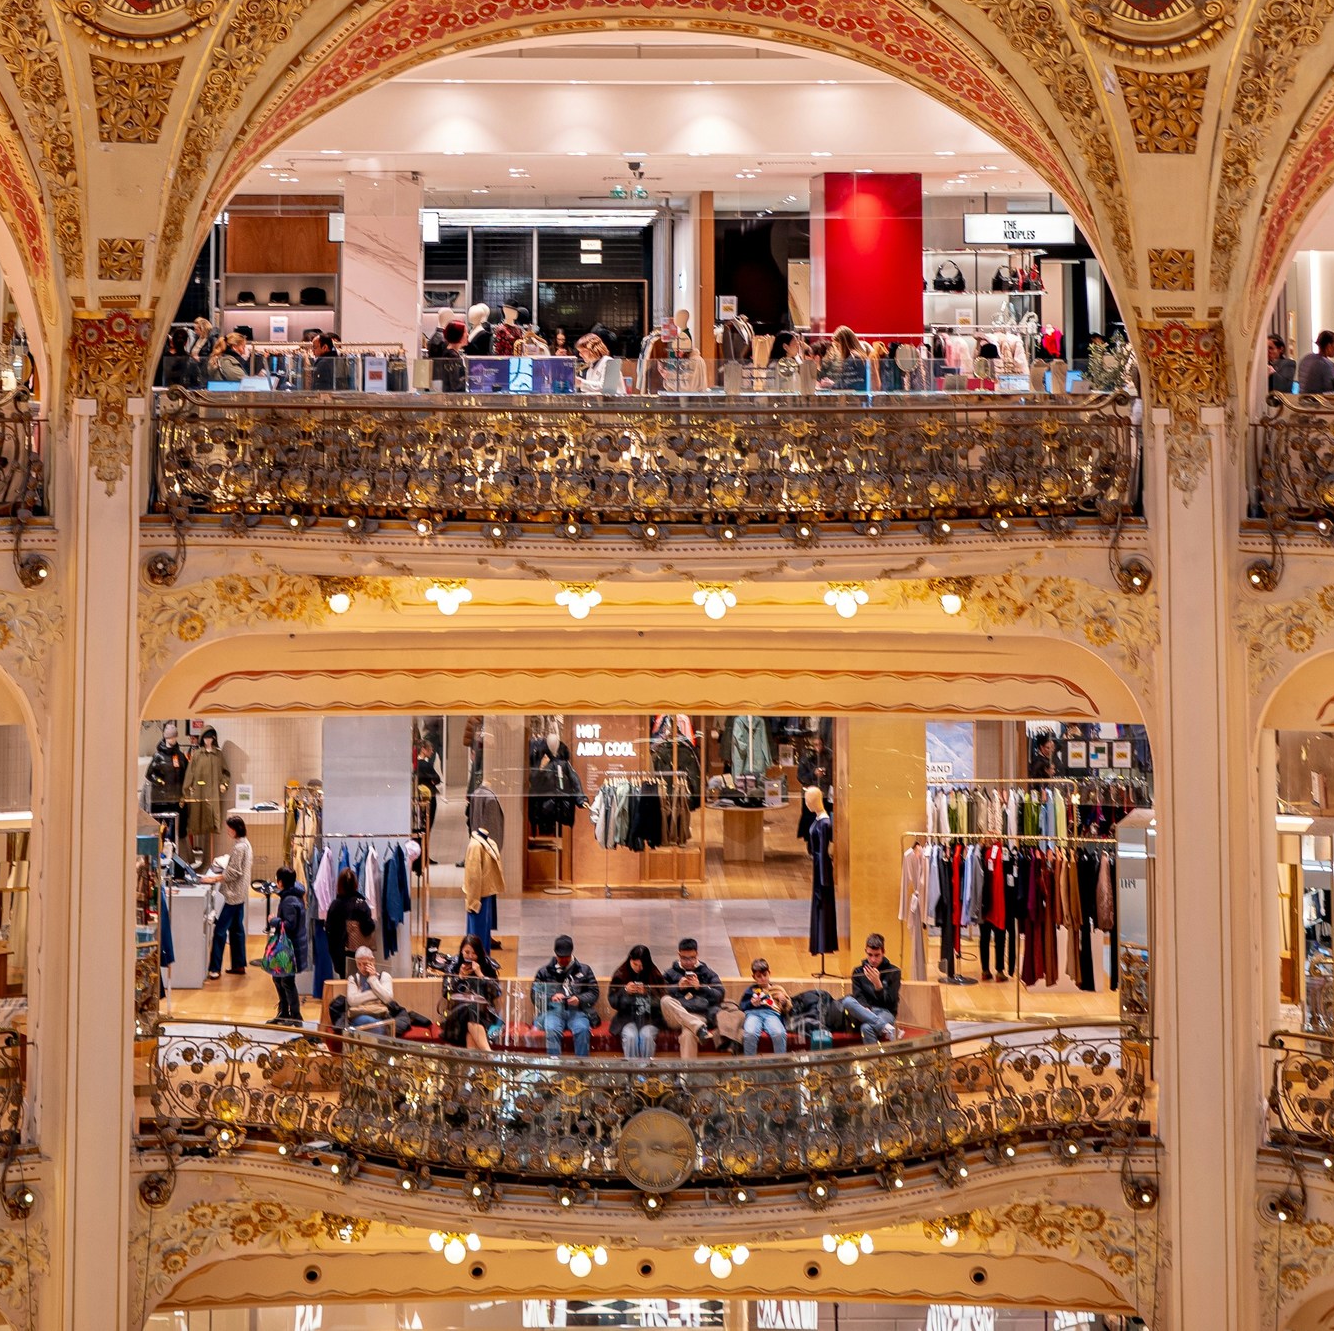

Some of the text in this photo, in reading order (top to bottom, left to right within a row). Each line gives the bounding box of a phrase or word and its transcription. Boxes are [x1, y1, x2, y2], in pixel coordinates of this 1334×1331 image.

[1003, 220, 1017, 229] THE
[576, 724, 601, 739] HOT
[577, 742, 636, 757] AND COOL
